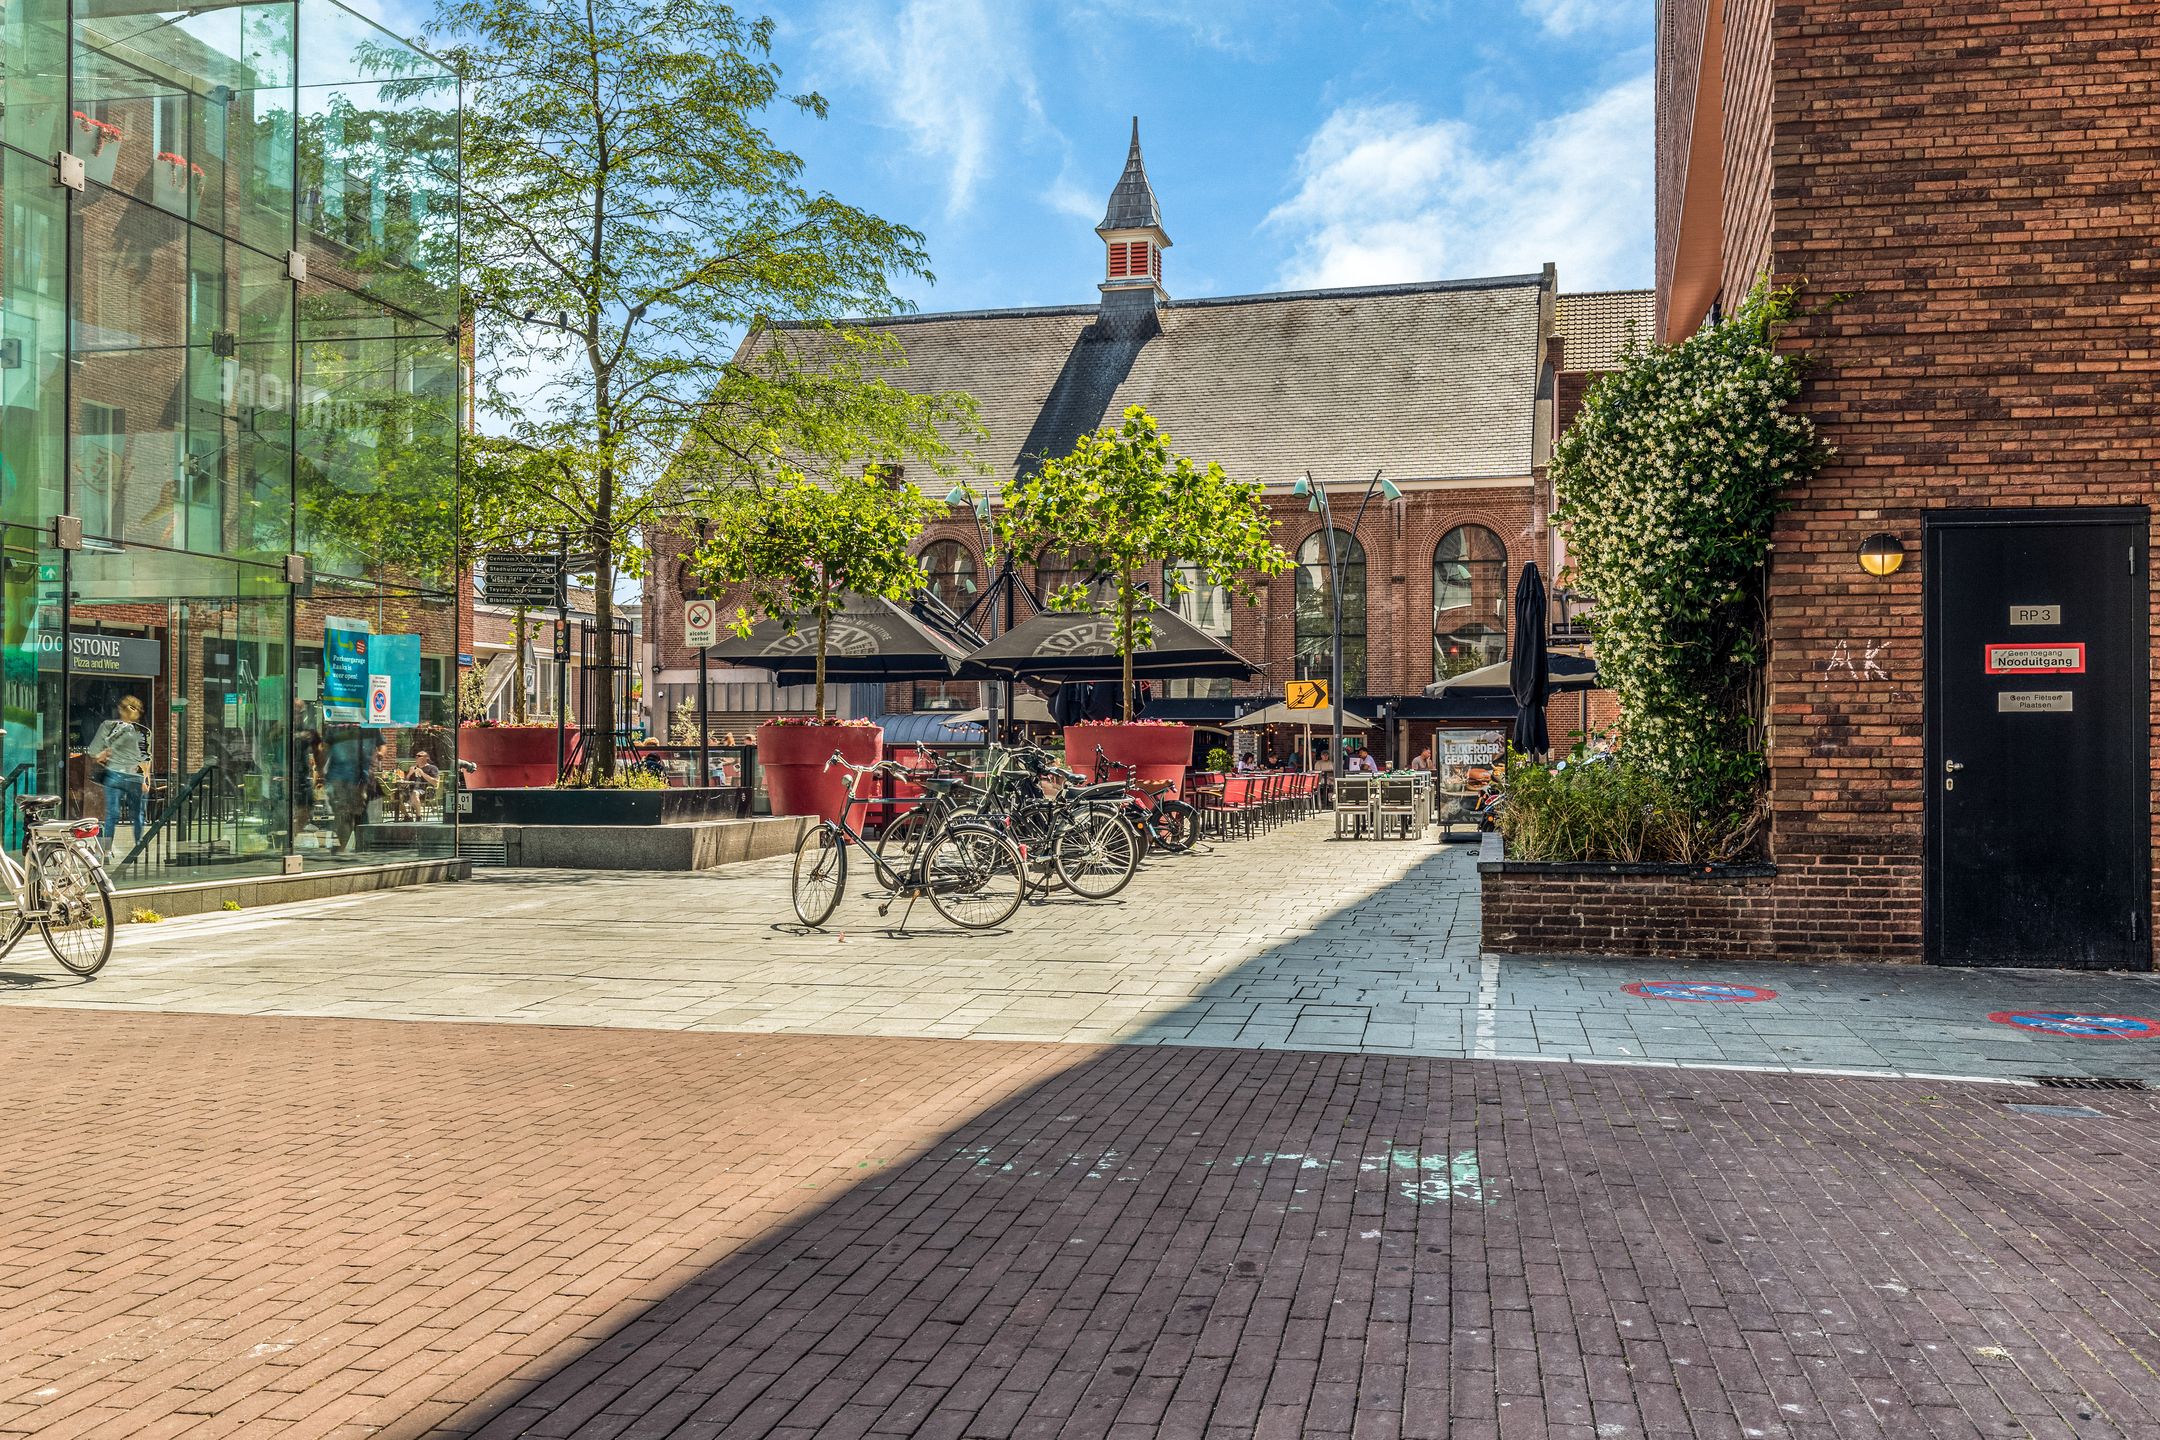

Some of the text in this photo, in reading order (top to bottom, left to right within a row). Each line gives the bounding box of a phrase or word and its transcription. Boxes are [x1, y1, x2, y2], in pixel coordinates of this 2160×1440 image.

[2020, 610, 2051, 620] RP 3
[38, 633, 120, 657] OOSTONE
[73, 656, 120, 670] Pizza and Wine
[1998, 657, 2073, 667] Nooduitgang
[1444, 743, 1500, 755] LEKKERDER
[1444, 754, 1493, 765] GEPRIJSD!
